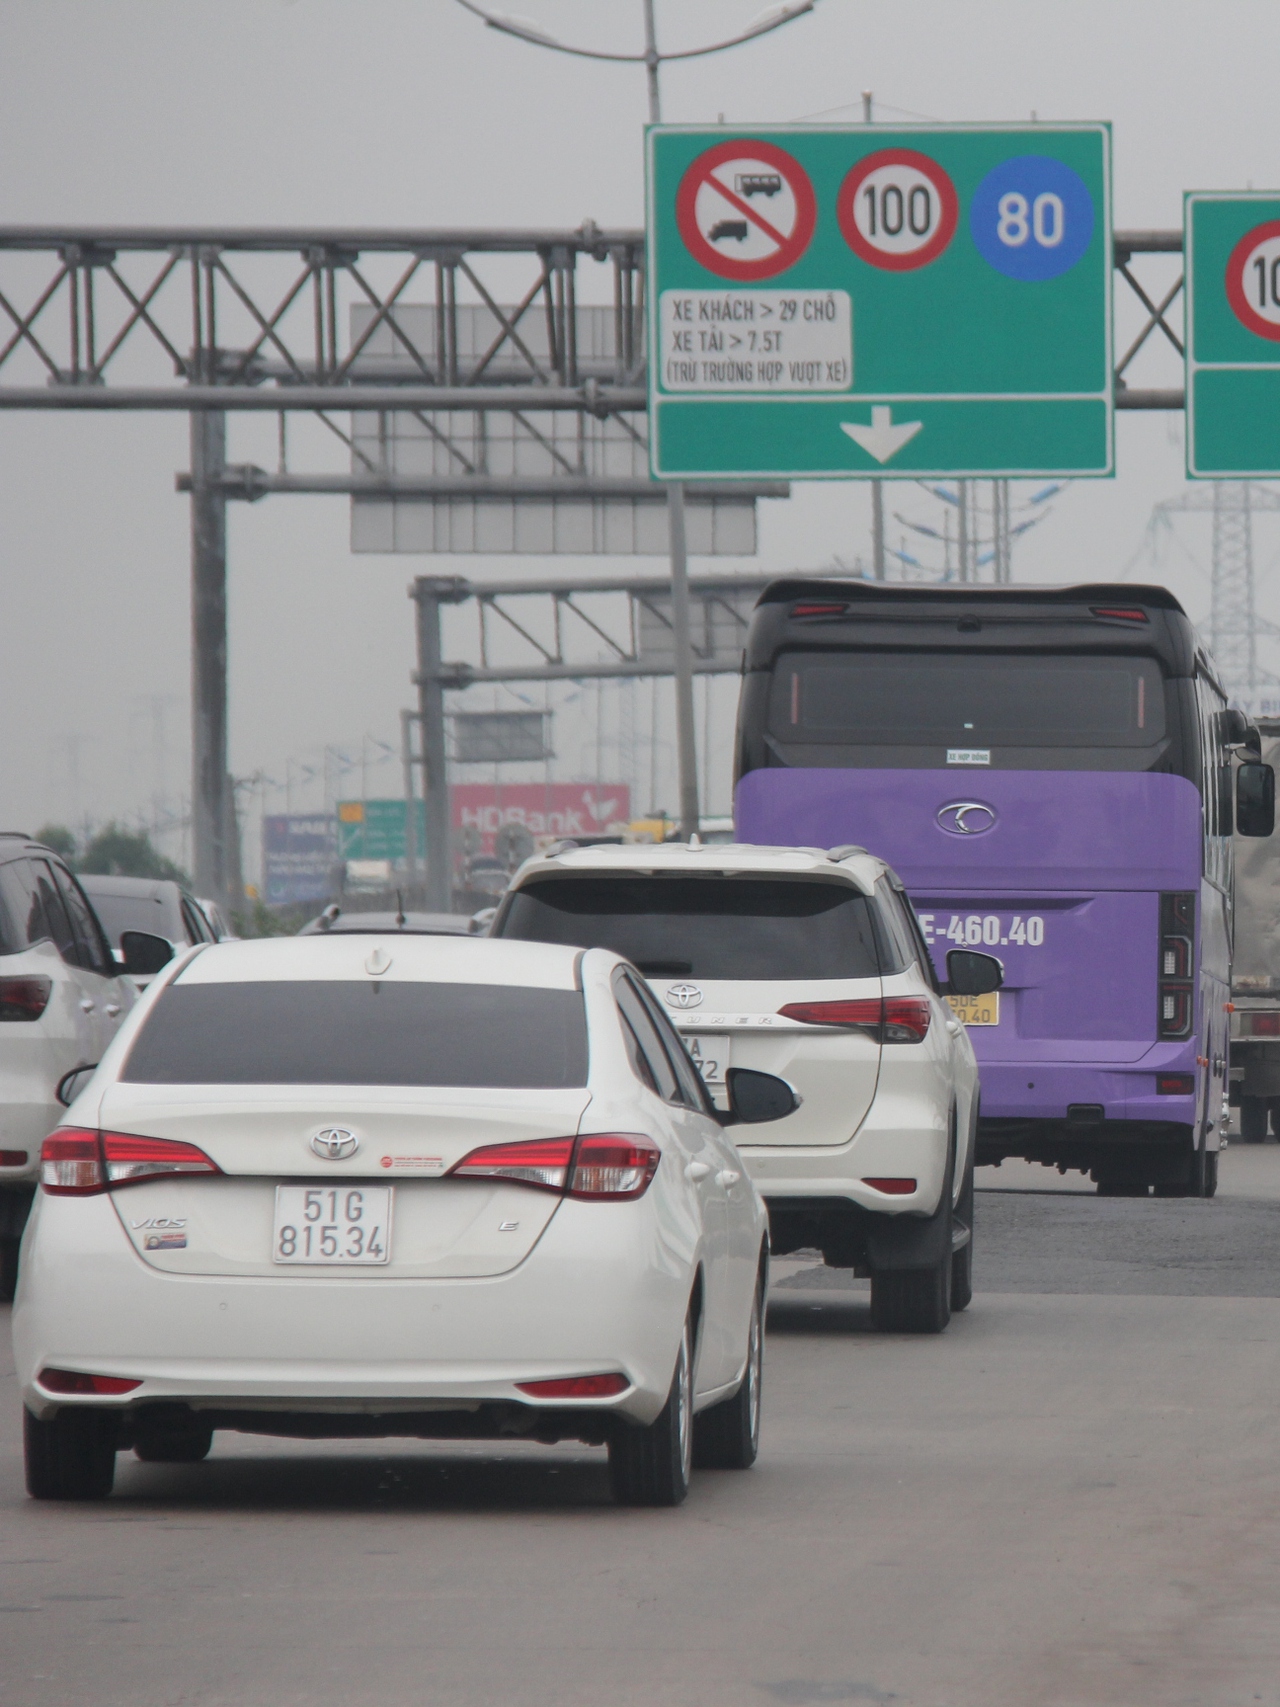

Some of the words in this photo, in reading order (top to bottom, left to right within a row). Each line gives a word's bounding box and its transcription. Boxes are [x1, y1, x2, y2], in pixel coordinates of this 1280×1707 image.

[863, 184, 932, 237] 100
[997, 192, 1064, 247] 80
[672, 300, 693, 321] XE
[699, 294, 754, 321] KHÁCH
[779, 300, 798, 321] 29
[672, 331, 693, 351] XE
[698, 324, 724, 351] TẢI
[748, 331, 783, 352] 7.5T
[702, 358, 753, 382] TRƯỜNG
[757, 360, 783, 384] HỢP
[788, 359, 822, 385] VƯỢT
[826, 358, 847, 384] XE)
[952, 1008, 991, 1024] 0.40
[303, 1190, 363, 1223] 51G
[131, 1218, 187, 1230] VIOS
[498, 1221, 520, 1232] E
[278, 1225, 384, 1258] 815.34
